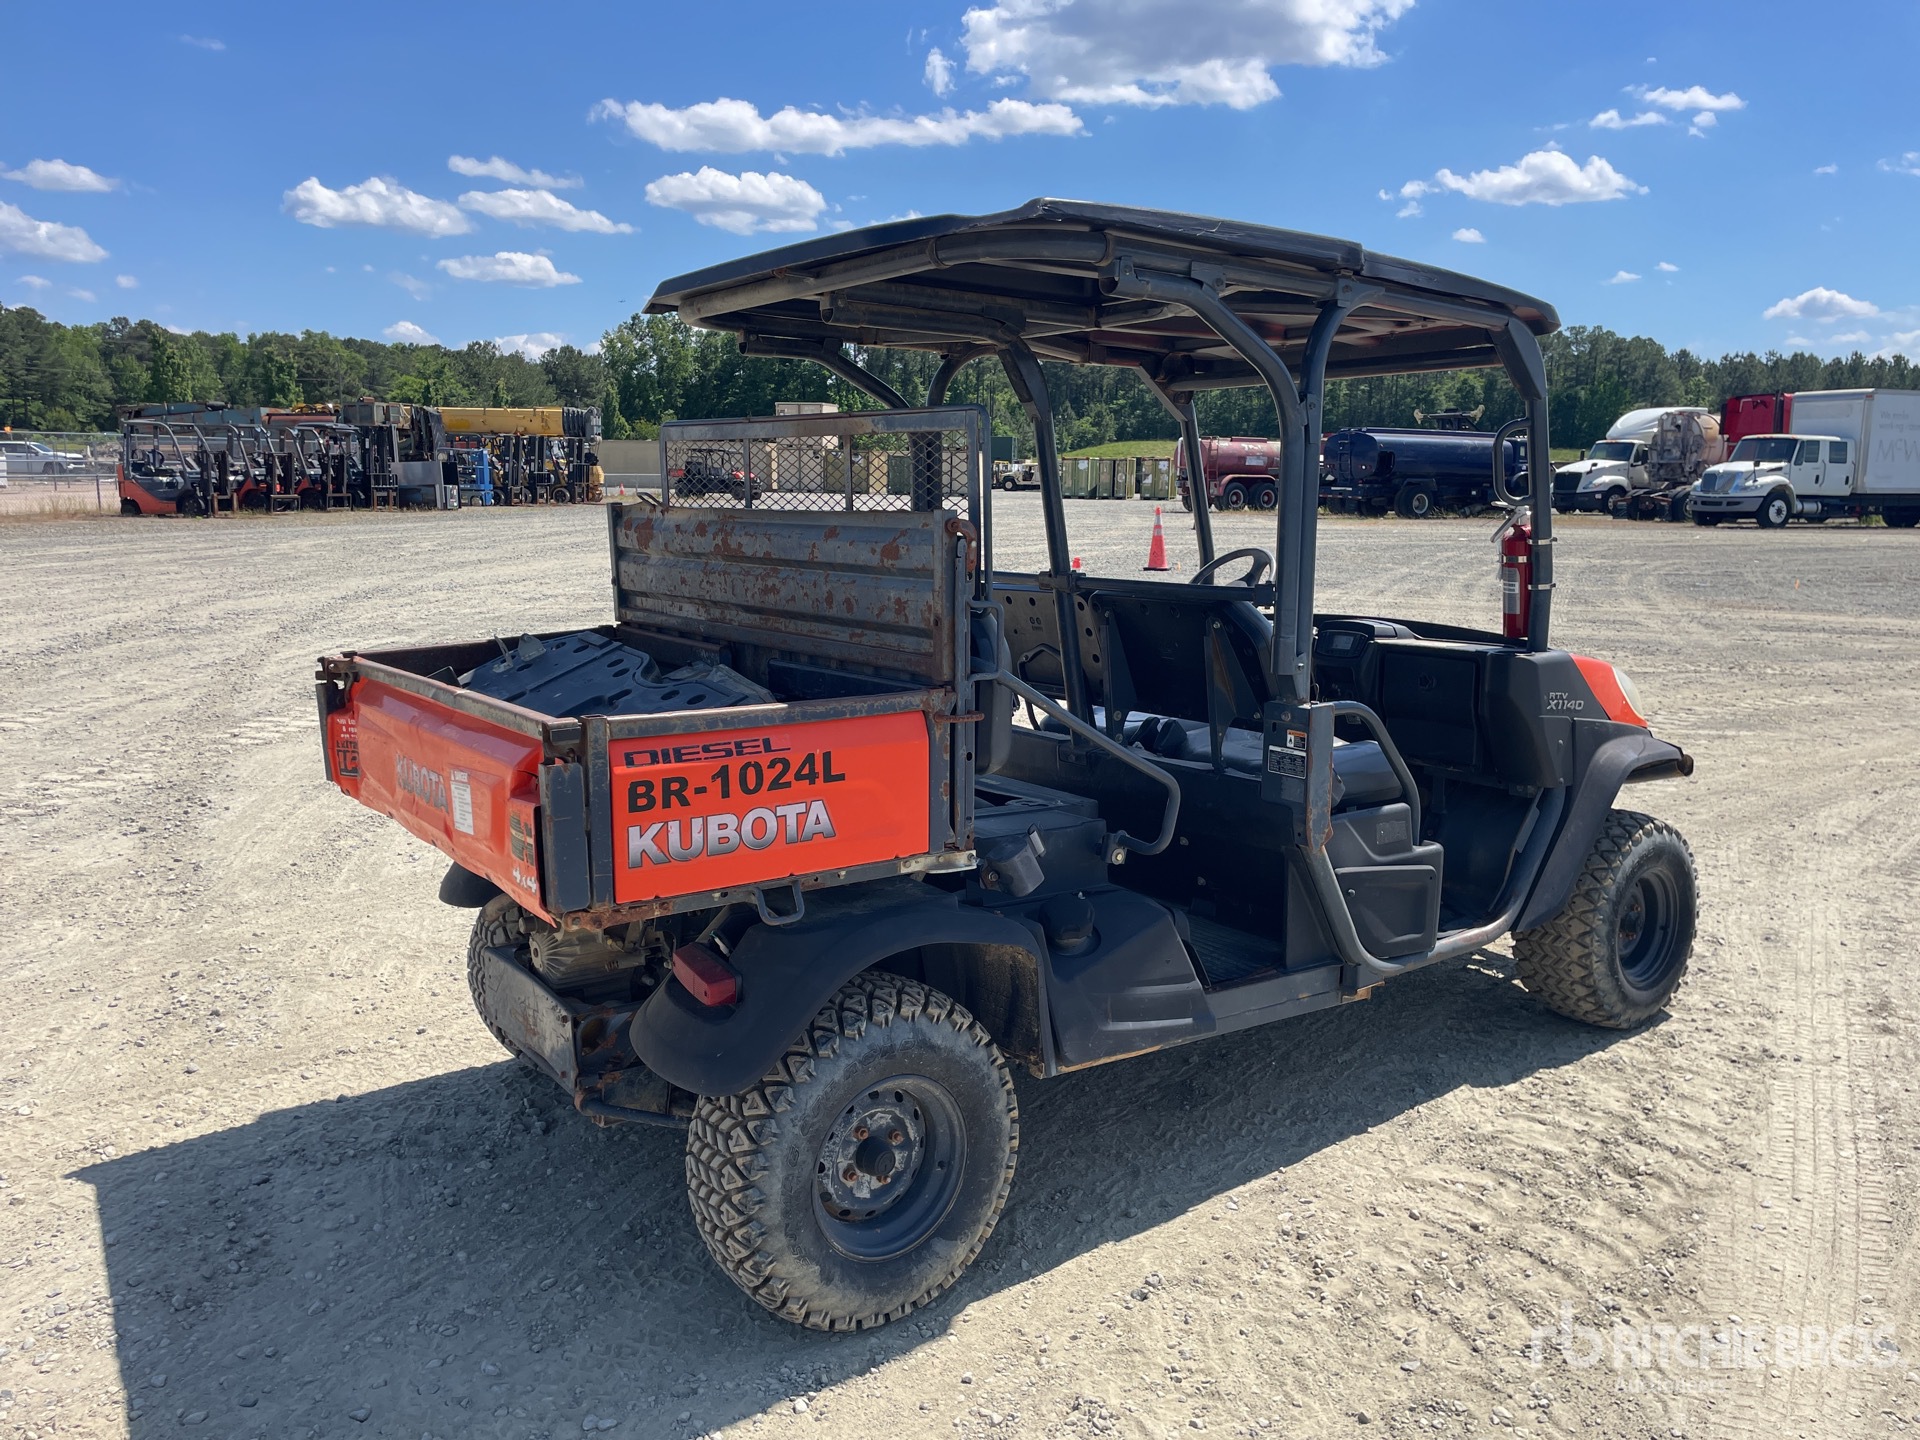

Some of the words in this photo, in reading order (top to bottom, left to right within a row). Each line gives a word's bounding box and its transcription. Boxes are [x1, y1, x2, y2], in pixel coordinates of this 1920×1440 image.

[1549, 692, 1568, 700] RTV
[396, 752, 449, 815] KUBOTA
[623, 737, 791, 769] DIESEL
[628, 751, 846, 813] BR-1024L
[628, 799, 836, 869] KUBOTA
